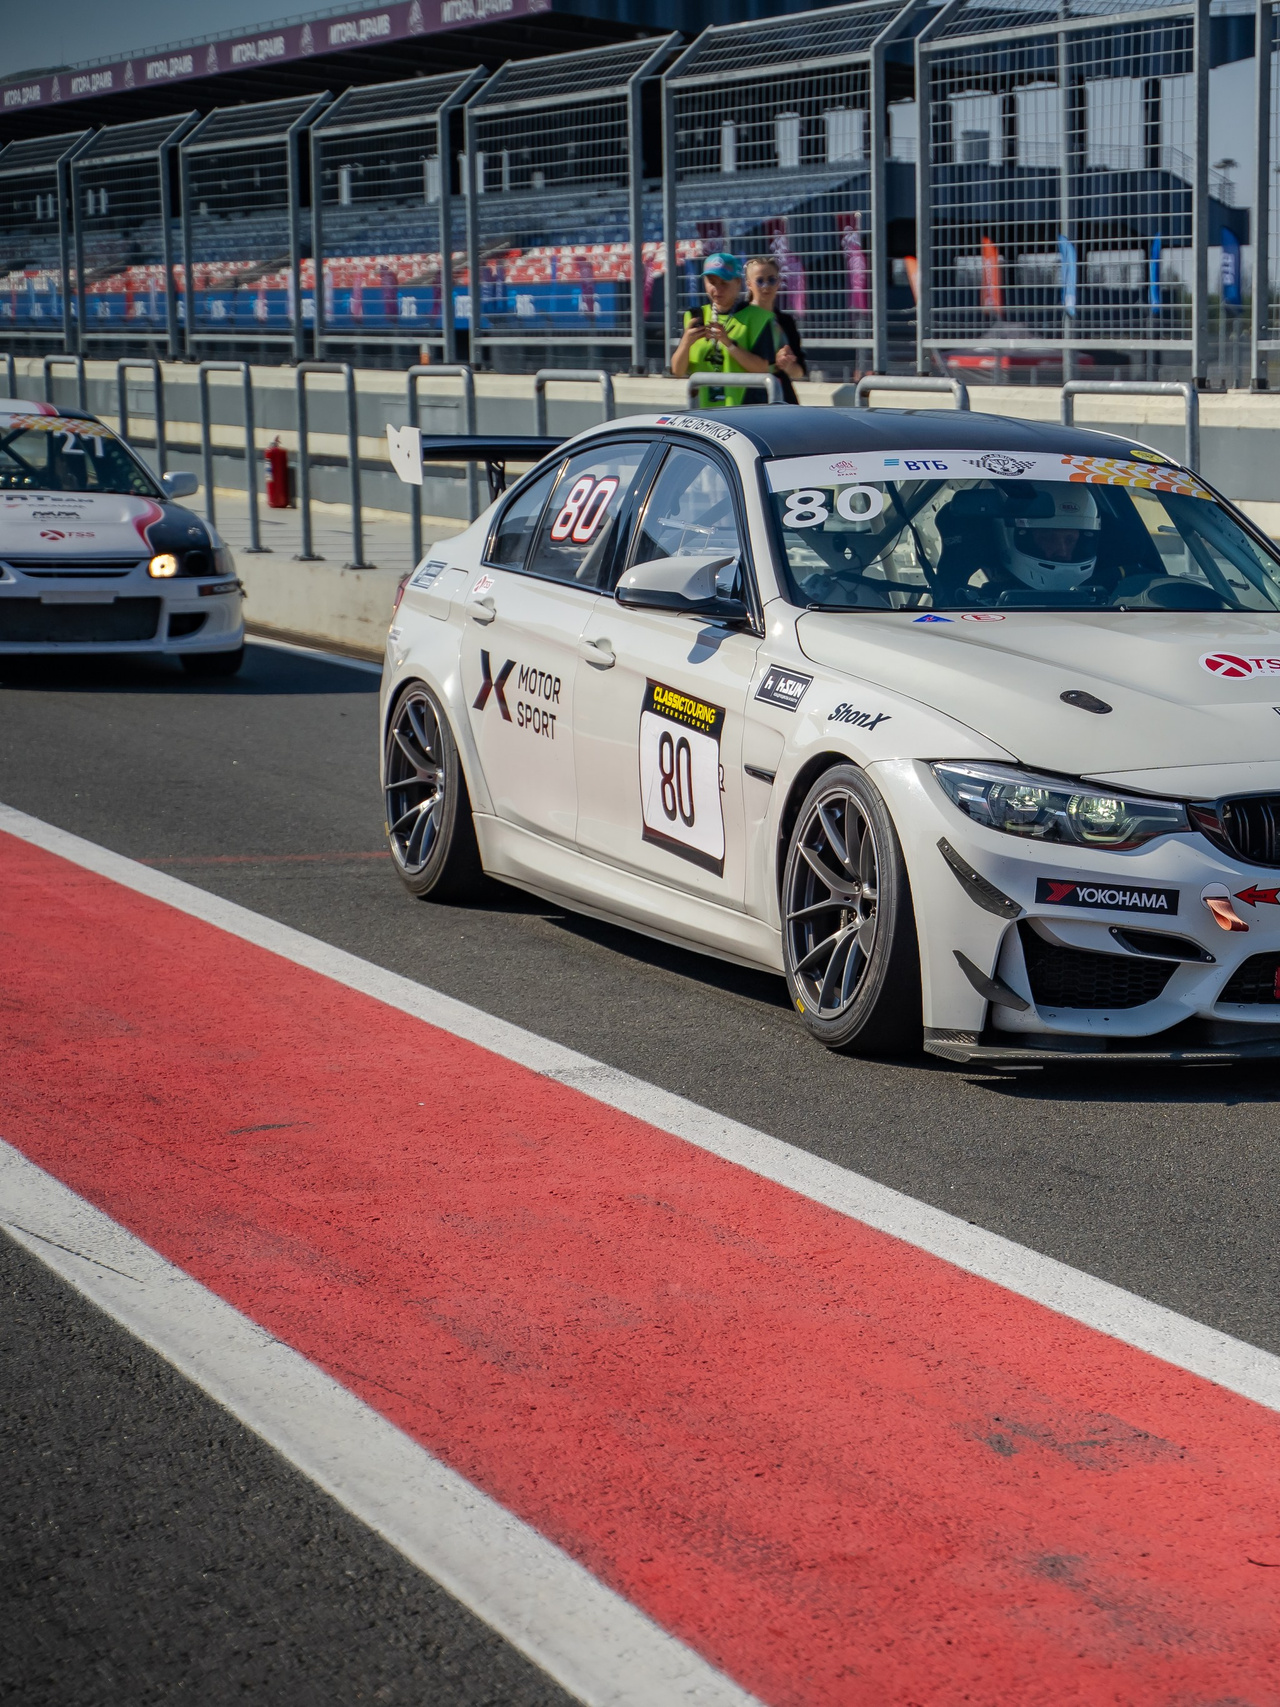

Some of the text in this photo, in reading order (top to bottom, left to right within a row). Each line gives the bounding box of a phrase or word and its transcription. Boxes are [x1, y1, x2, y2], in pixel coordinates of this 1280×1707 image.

[329, 20, 358, 44] ИГОРА
[232, 41, 257, 63] ИГОРА
[677, 417, 737, 441] МЕЛЬНИКОВ
[903, 460, 949, 471] ВТБ
[551, 474, 620, 543] 80
[782, 485, 885, 528] 80
[517, 664, 561, 704] MOTOR
[517, 701, 556, 740] SPORT
[652, 702, 710, 731] INTERNATIONAL
[658, 731, 696, 829] 80
[1075, 886, 1168, 910] YOKOHAMA
